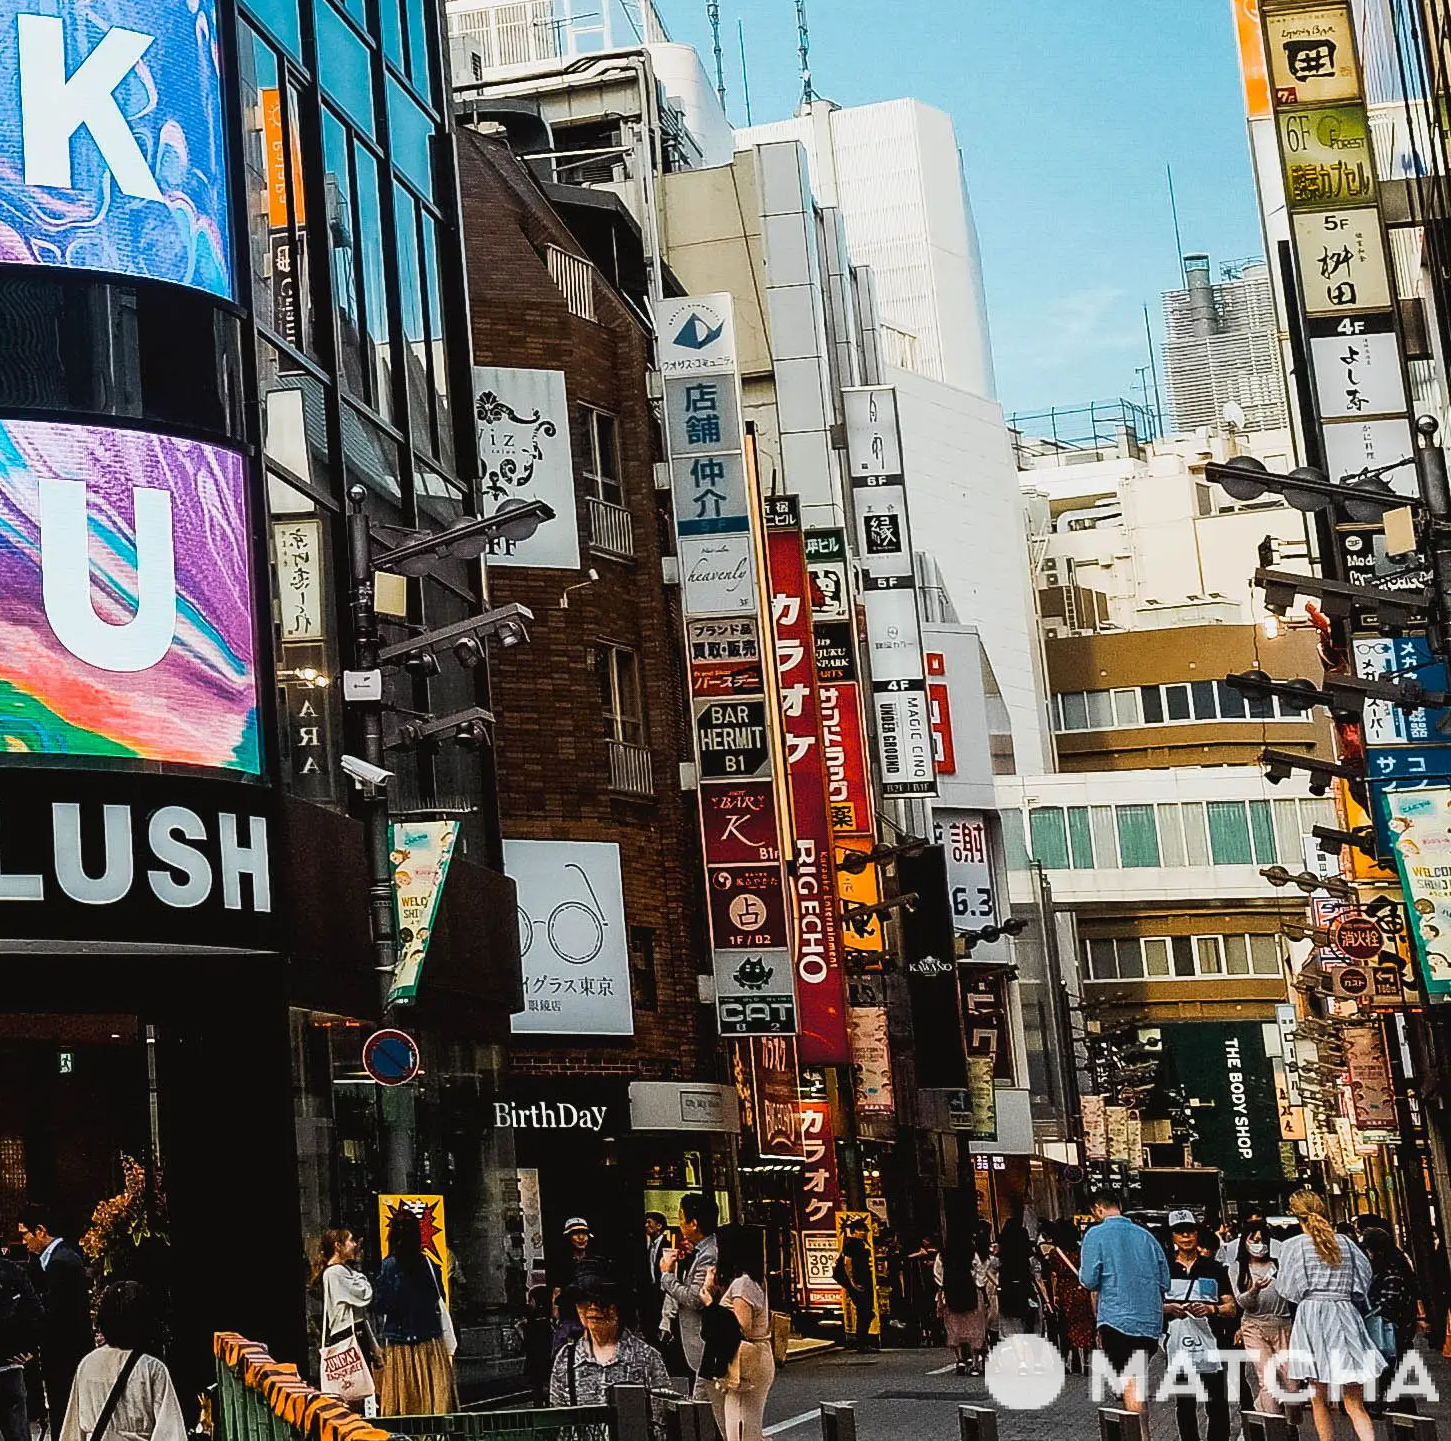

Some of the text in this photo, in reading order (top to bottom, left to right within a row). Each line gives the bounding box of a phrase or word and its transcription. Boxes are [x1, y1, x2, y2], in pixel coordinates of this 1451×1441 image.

[1286, 114, 1311, 153] 6F
[1323, 215, 1350, 231] 5F
[1336, 318, 1366, 335] 4F
[867, 475, 888, 486] 6F
[687, 557, 748, 593] heavenly
[877, 577, 898, 588] 5F
[693, 623, 753, 637] ブランド品
[771, 593, 816, 764] カラオケ
[887, 680, 910, 691] 4F
[1362, 658, 1385, 739] メガスーパー
[711, 705, 749, 725] BAR
[700, 726, 764, 751] HERMIT
[879, 703, 900, 774] UNDER GROUND
[906, 697, 926, 778] MAGIC CINQ
[724, 755, 746, 772] B1
[719, 795, 760, 811] BAR
[832, 804, 854, 828] 薬
[720, 813, 766, 847] K
[798, 900, 828, 984] ECHO
[823, 895, 838, 968] Entertainment
[1341, 931, 1380, 948] 消火栓
[720, 1002, 793, 1022] CAT
[1224, 1037, 1241, 1069] THE
[1228, 1071, 1247, 1116] BODY
[492, 1100, 608, 1132] BirthDay
[800, 1109, 833, 1223] カラオケ
